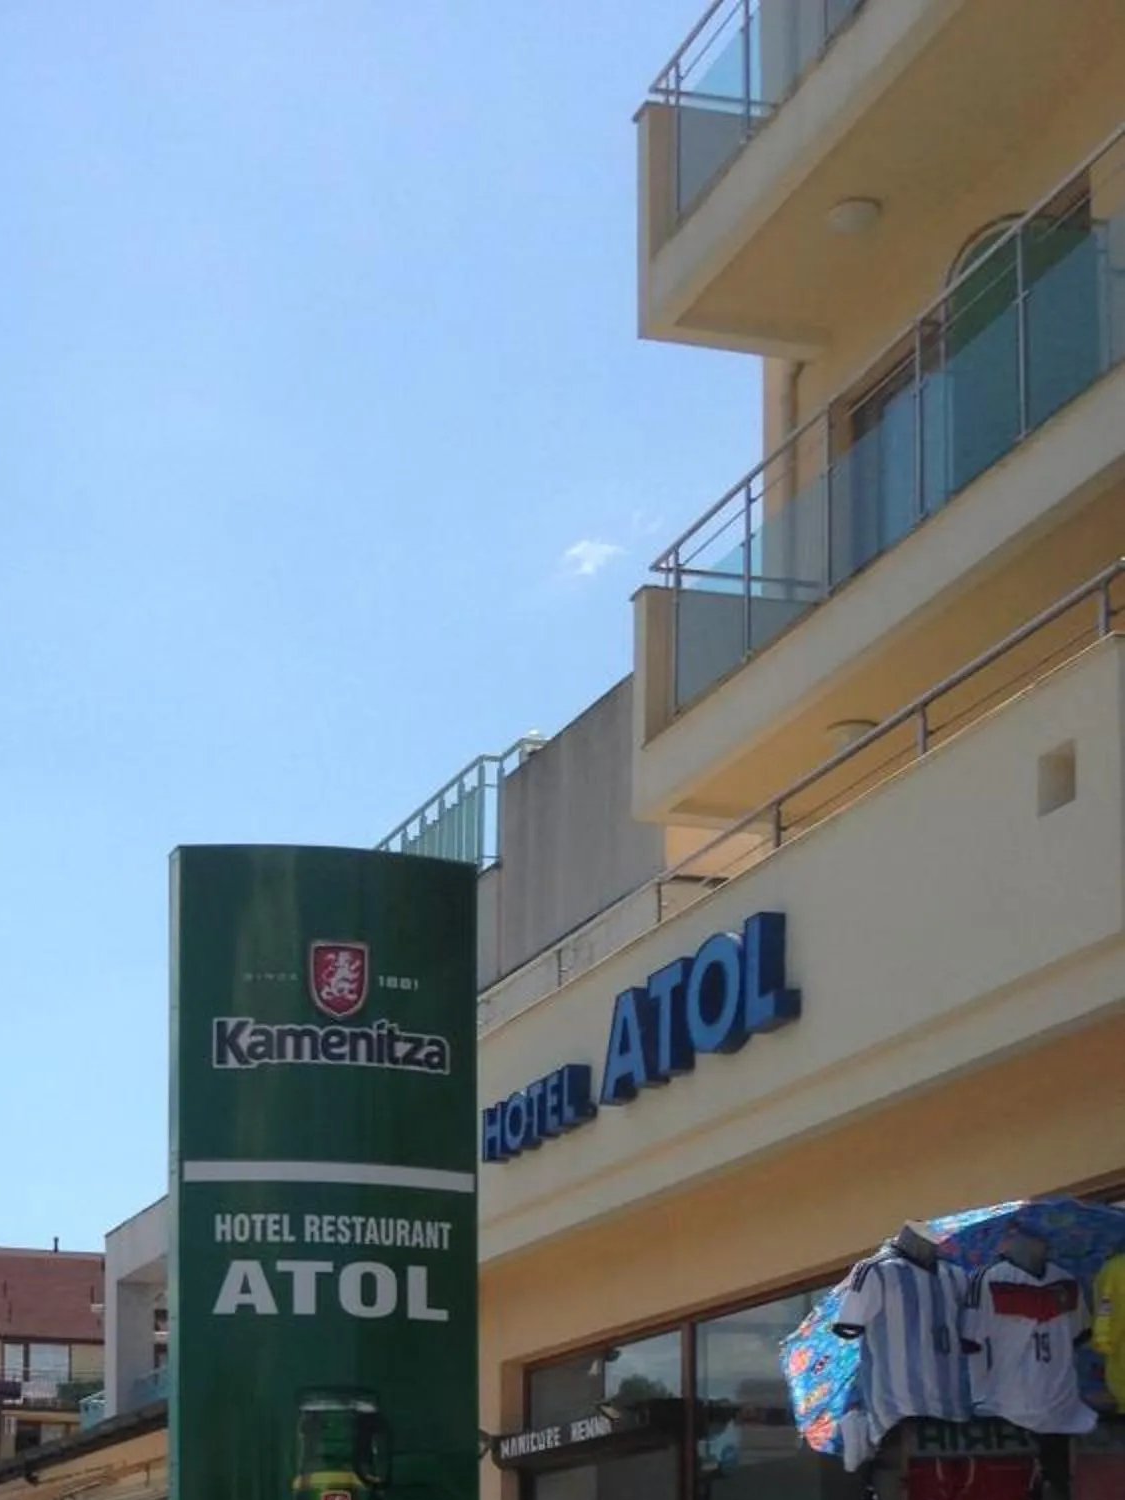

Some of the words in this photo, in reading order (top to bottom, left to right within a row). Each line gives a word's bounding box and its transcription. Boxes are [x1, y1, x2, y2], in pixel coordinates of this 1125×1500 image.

[213, 1017, 451, 1075] Kamenitza
[482, 1064, 598, 1163] HOTEL
[600, 911, 801, 1106] ATOL
[215, 1213, 296, 1243] HOTEL
[304, 1214, 452, 1250] RESTAURANT
[213, 1260, 450, 1322] ATOL
